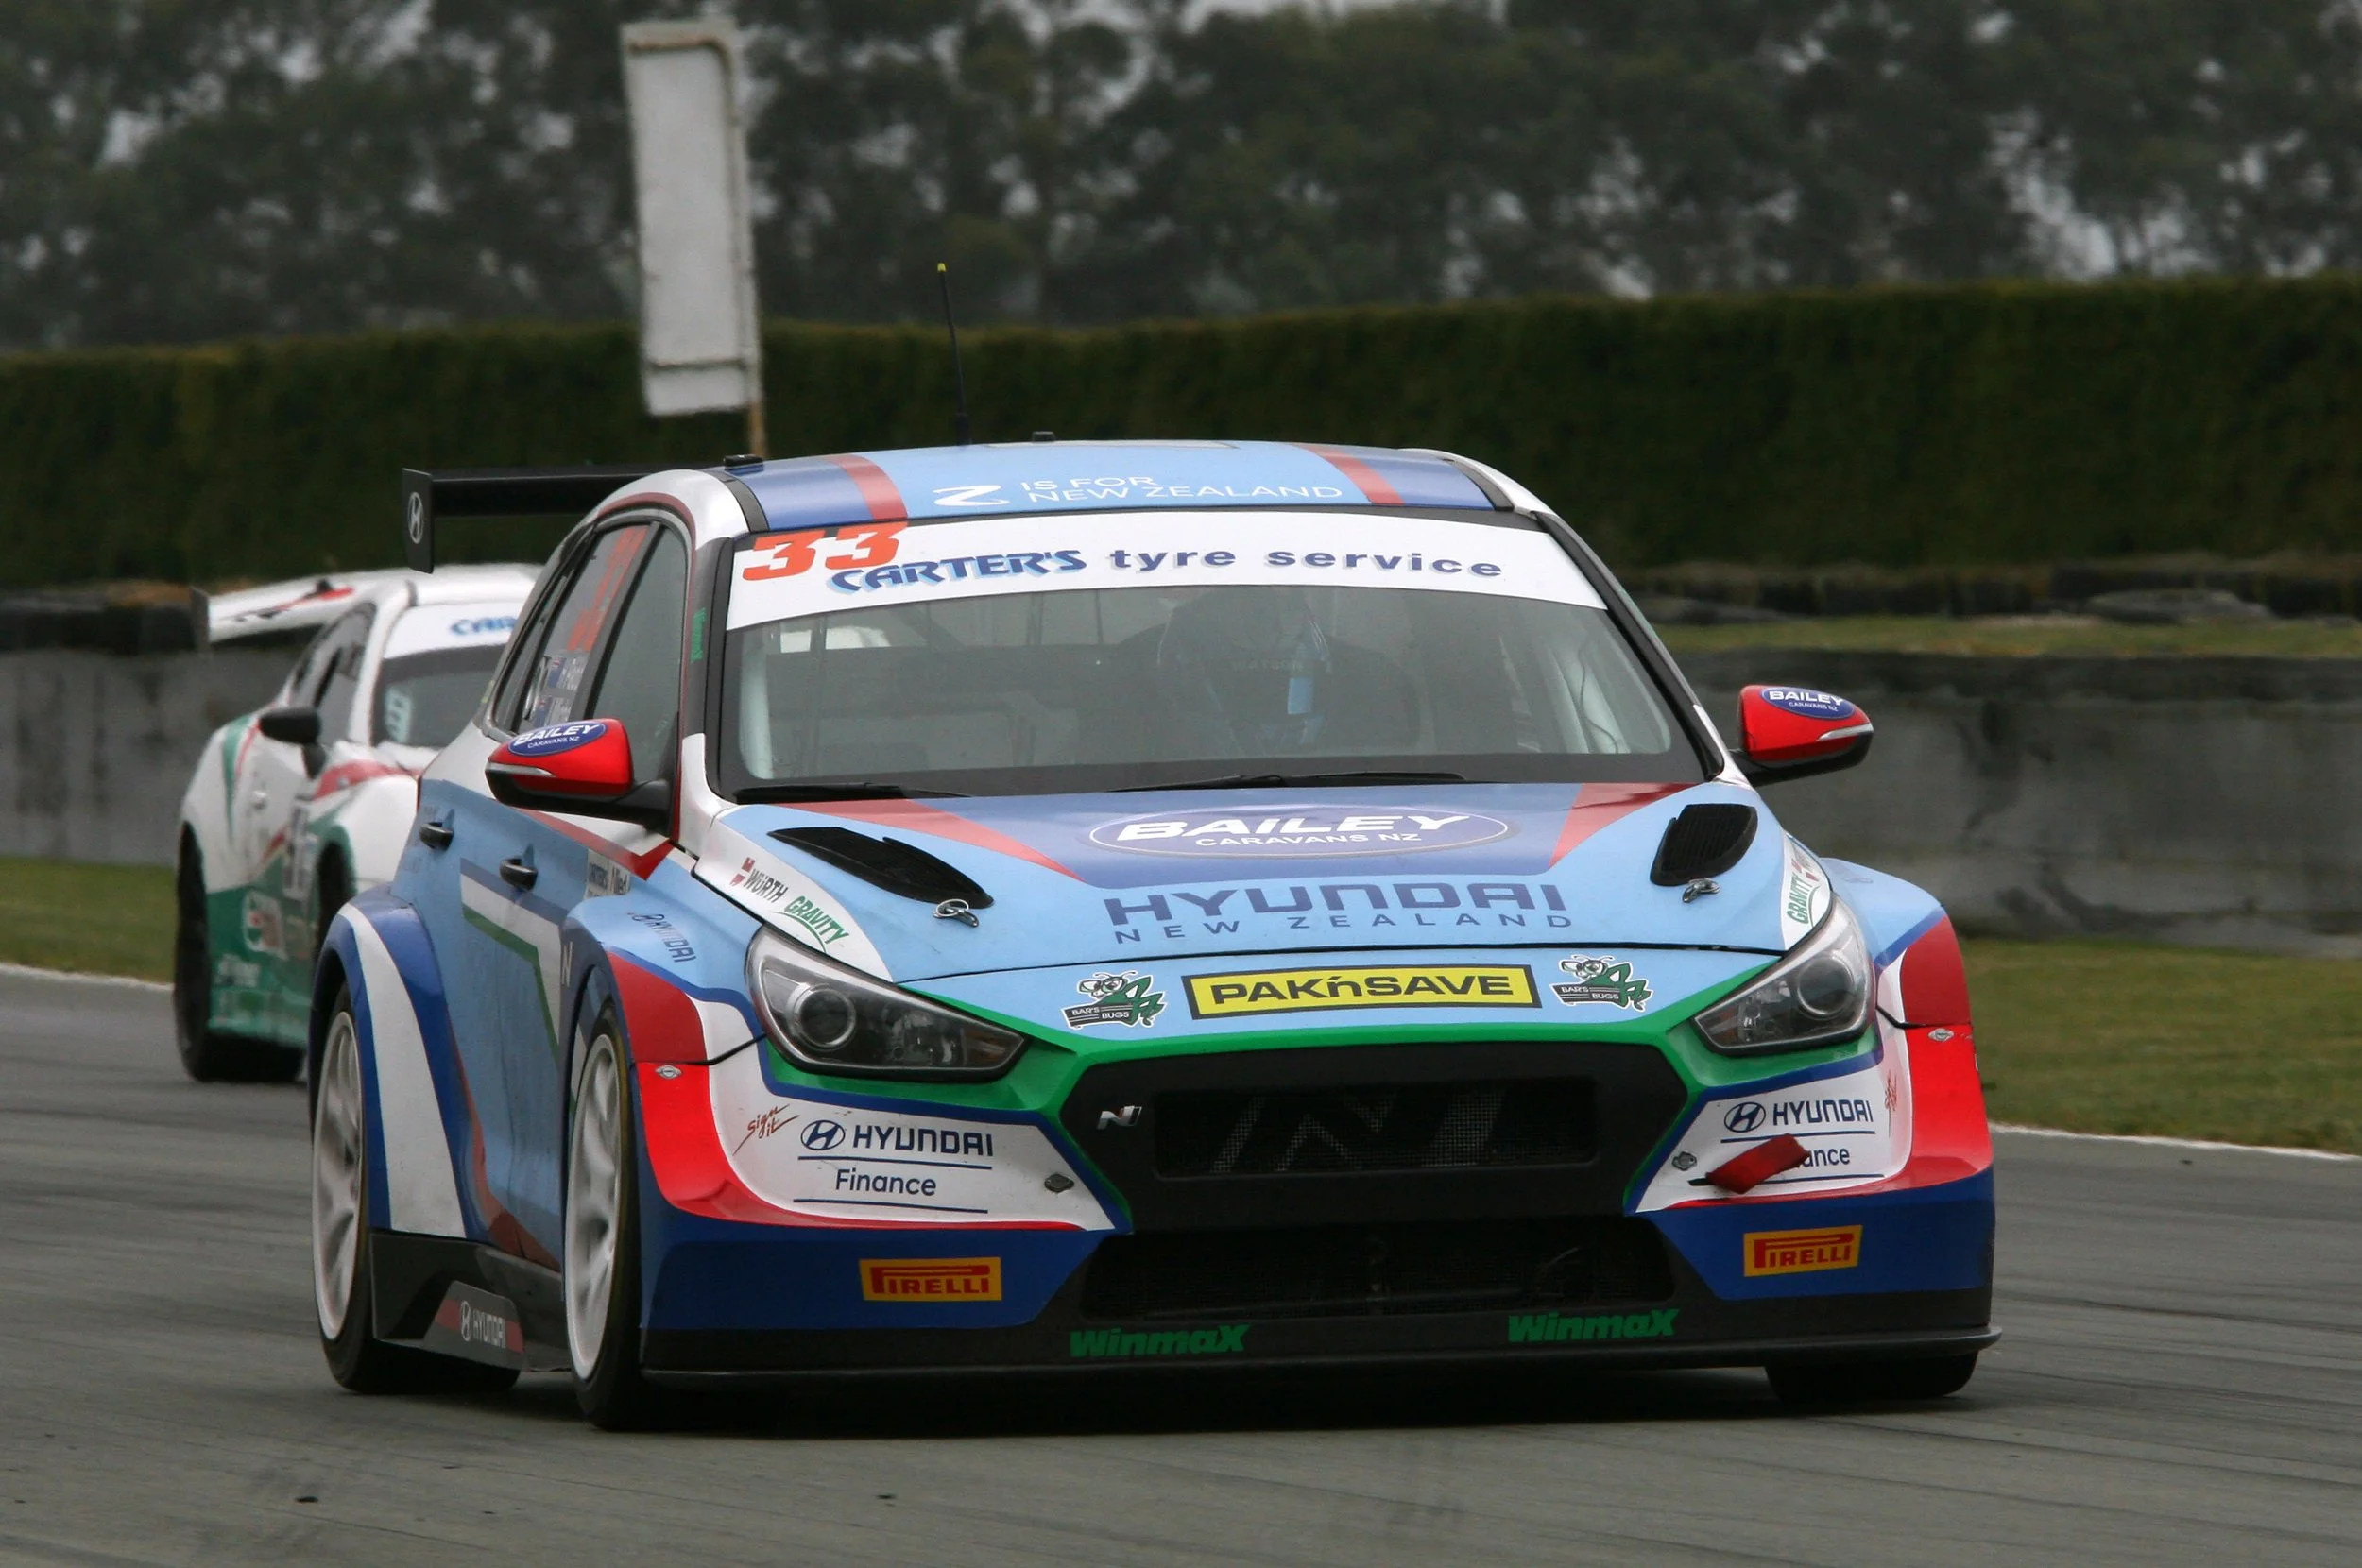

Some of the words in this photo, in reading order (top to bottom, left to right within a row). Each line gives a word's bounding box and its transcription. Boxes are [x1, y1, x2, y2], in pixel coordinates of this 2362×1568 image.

[1022, 479, 1066, 492] IS
[1070, 476, 1154, 488] FOR
[1028, 487, 1128, 503] NEW
[1143, 486, 1342, 499] ZEALAND
[742, 520, 909, 581] 33
[827, 549, 1087, 593] CARTER'S
[1110, 550, 1236, 572] tyre
[1266, 552, 1502, 577] service
[1769, 690, 1842, 706] BAILEY
[513, 724, 600, 746] BAILEY
[1117, 815, 1470, 842] BAILEY
[1196, 834, 1369, 847] CARAVANS
[1378, 832, 1422, 842] NZ
[1104, 883, 1566, 926] HYUNDAI
[784, 895, 849, 945] GRAVITY
[1115, 920, 1240, 944] NEW
[1286, 913, 1572, 929] ZEALAND
[1772, 1100, 1874, 1126] HYUNDAI
[851, 1124, 994, 1157] HYUNDAI
[835, 1168, 937, 1197] Finance
[1754, 1233, 1854, 1269] PIRELLI
[871, 1265, 990, 1294] PIRELLI
